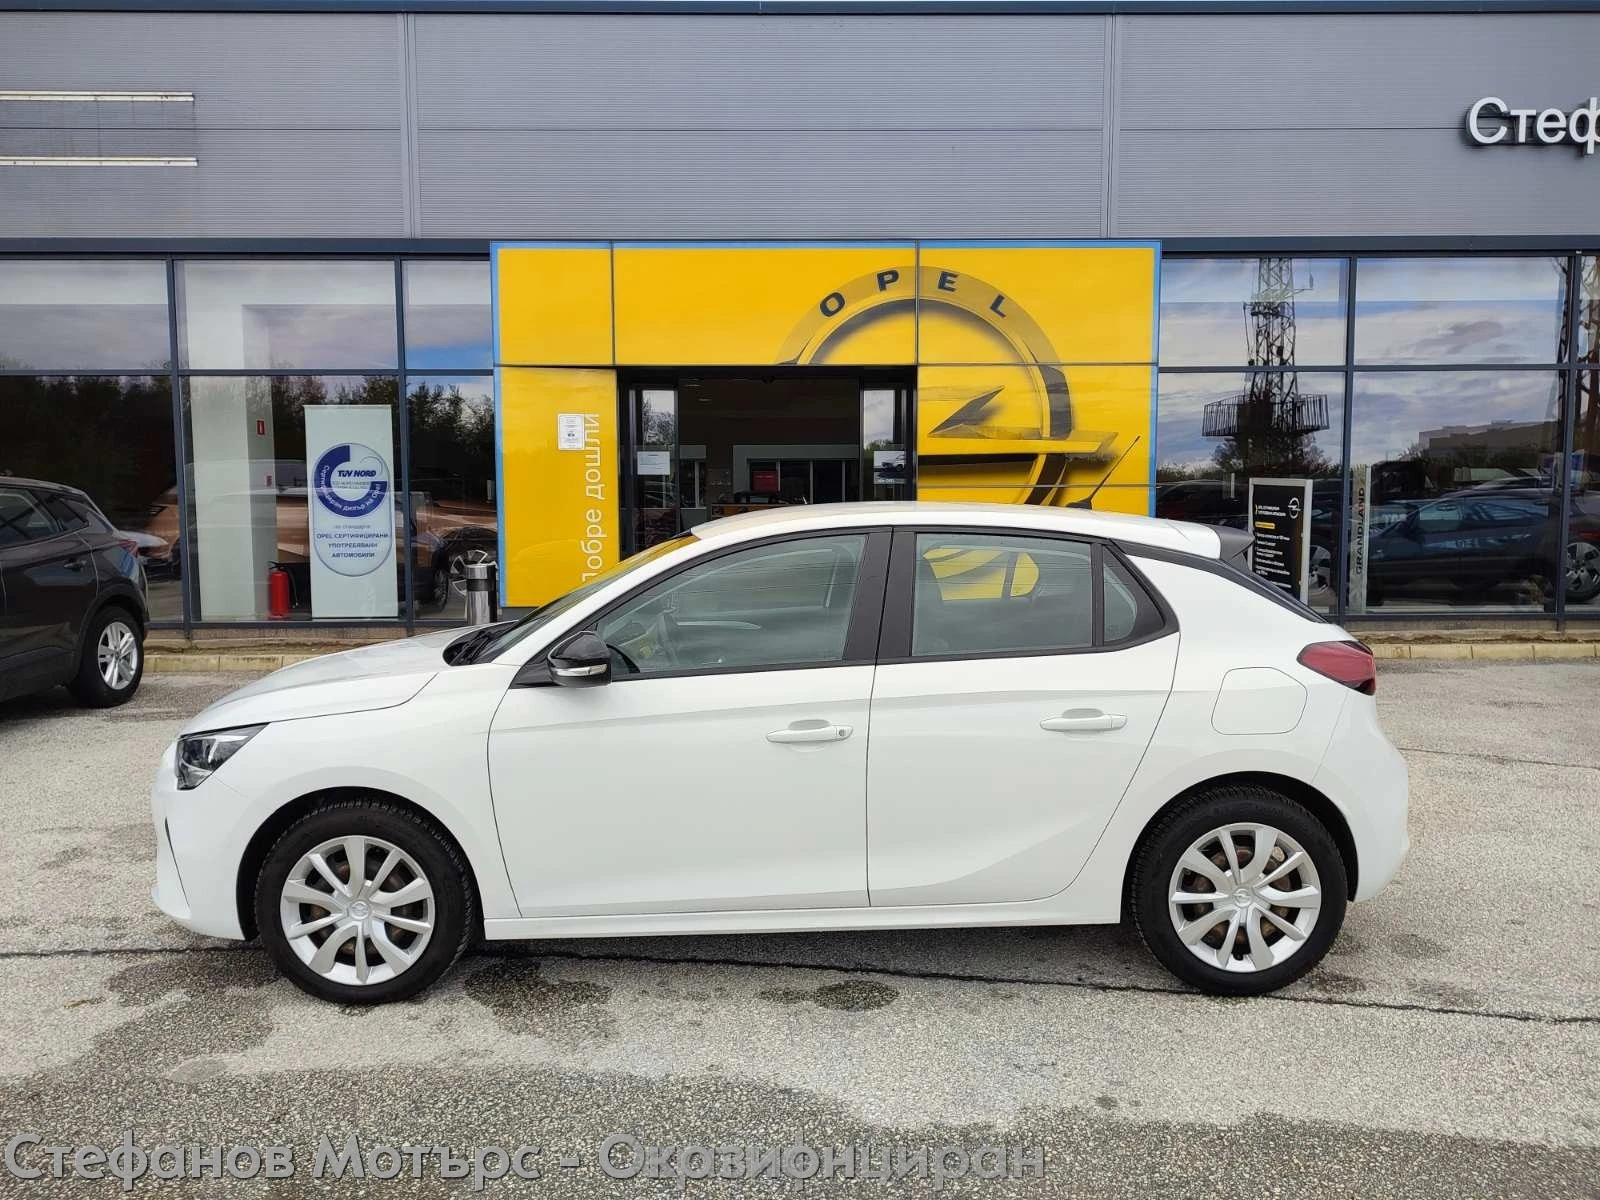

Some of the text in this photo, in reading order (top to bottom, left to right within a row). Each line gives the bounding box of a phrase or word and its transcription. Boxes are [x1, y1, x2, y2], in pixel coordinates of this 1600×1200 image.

[1469, 96, 1600, 154] Стеф
[819, 269, 1007, 318] OPEL
[337, 470, 377, 478] TÜV NORD
[585, 413, 605, 500] дошли
[1356, 487, 1365, 575] GRANDLAND
